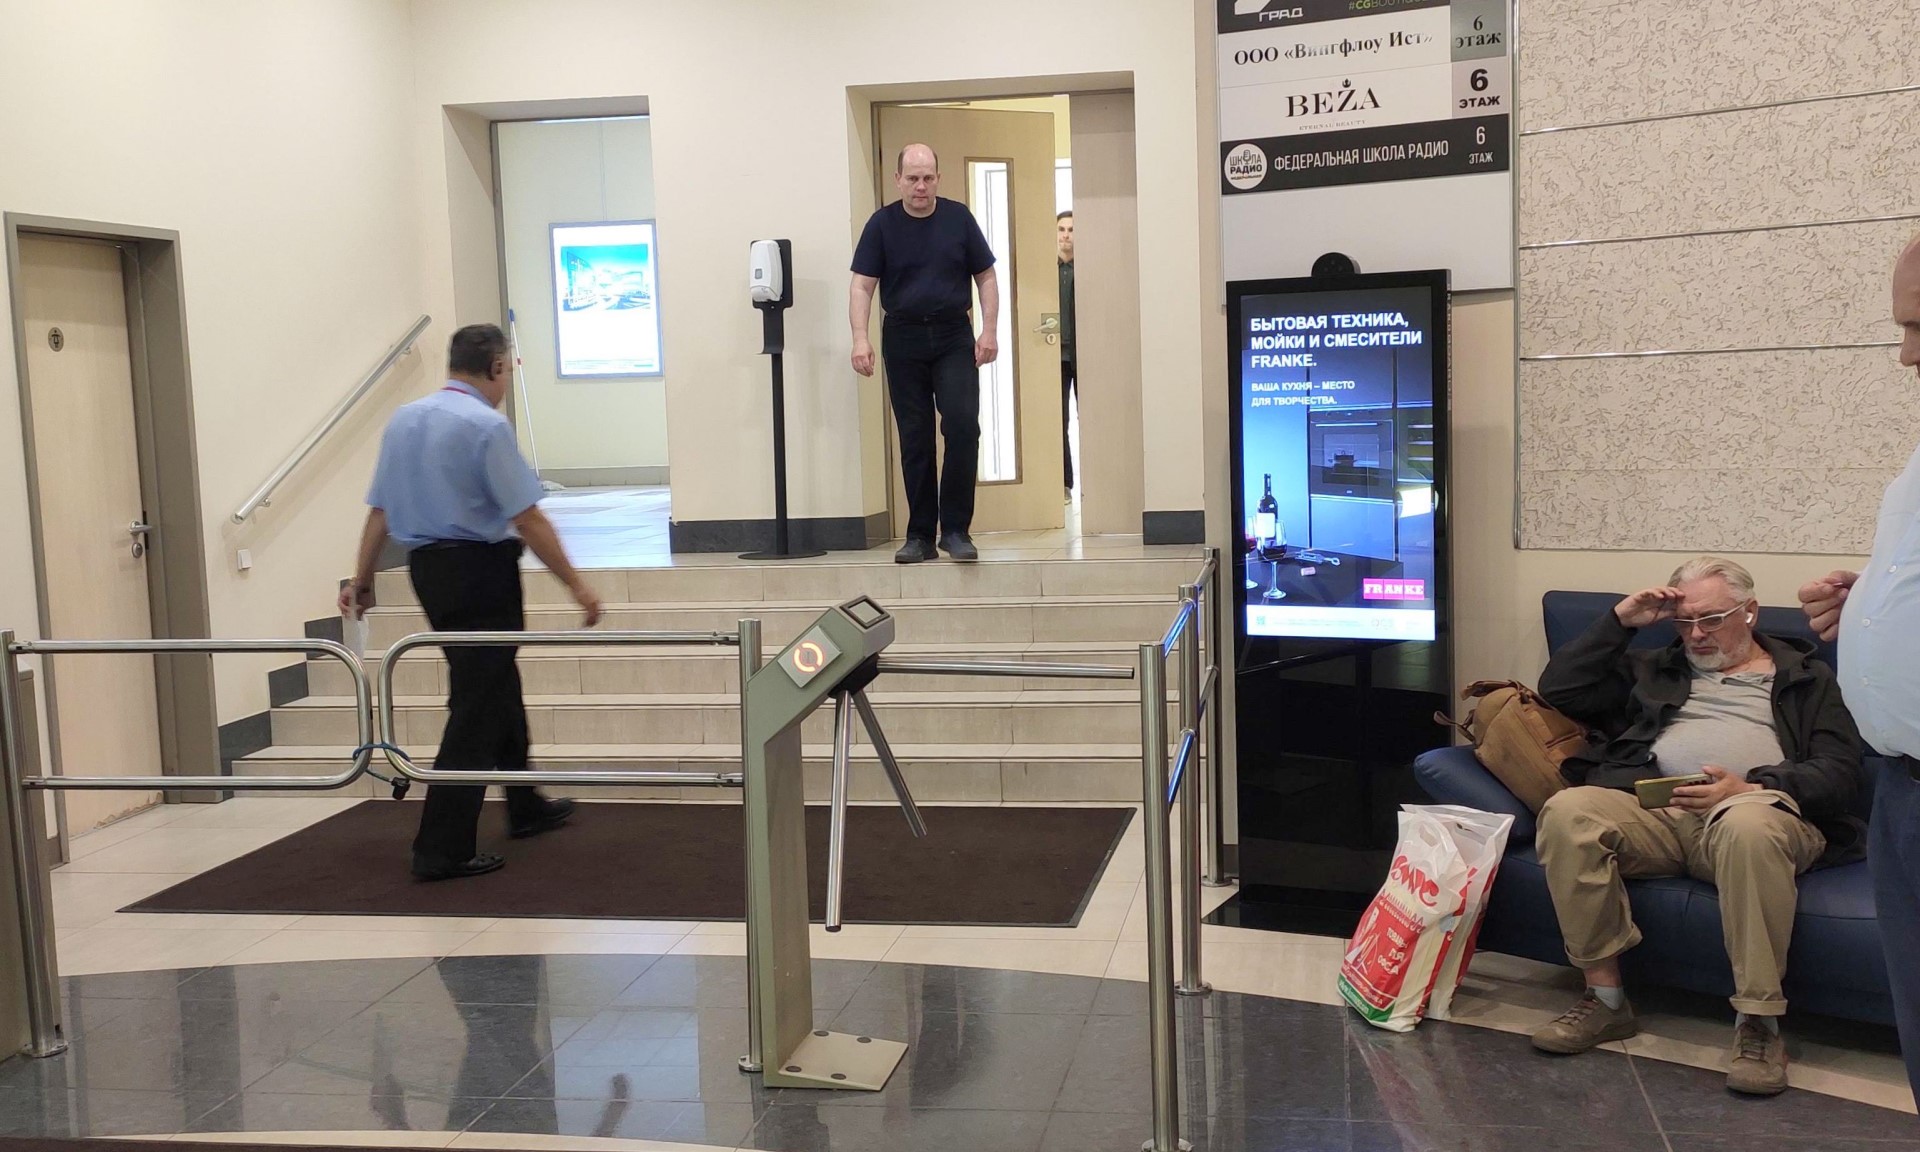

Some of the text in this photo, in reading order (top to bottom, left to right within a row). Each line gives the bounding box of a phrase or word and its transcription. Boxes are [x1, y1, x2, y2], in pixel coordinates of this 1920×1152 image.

[1258, 7, 1304, 23] ГРАД
[1473, 15, 1483, 31] 6
[1455, 31, 1502, 49] этаж
[1234, 47, 1279, 66] ООО
[1470, 68, 1489, 92] 6
[1458, 94, 1501, 109] ЭТАЖ
[1475, 126, 1486, 145] 6
[1274, 140, 1450, 172] ФЕДЕРАЛЬНАЯ ШКОЛА РАДИО
[1468, 152, 1494, 165] ЭТАЖ
[1230, 164, 1263, 174] РАДИО
[1250, 312, 1409, 332] БЫТОВАЯ ТЕХНИКА,
[1251, 331, 1423, 350] МОЙКИ И СМЕСИТЕЛИ
[1251, 353, 1317, 368] FRANKE.
[1251, 381, 1280, 392] ВАША
[1281, 381, 1313, 391] КУХНЯ
[1321, 380, 1356, 390] МЕСТО
[1251, 397, 1272, 407] ДЛЯ
[1364, 583, 1424, 595] FRANKE
